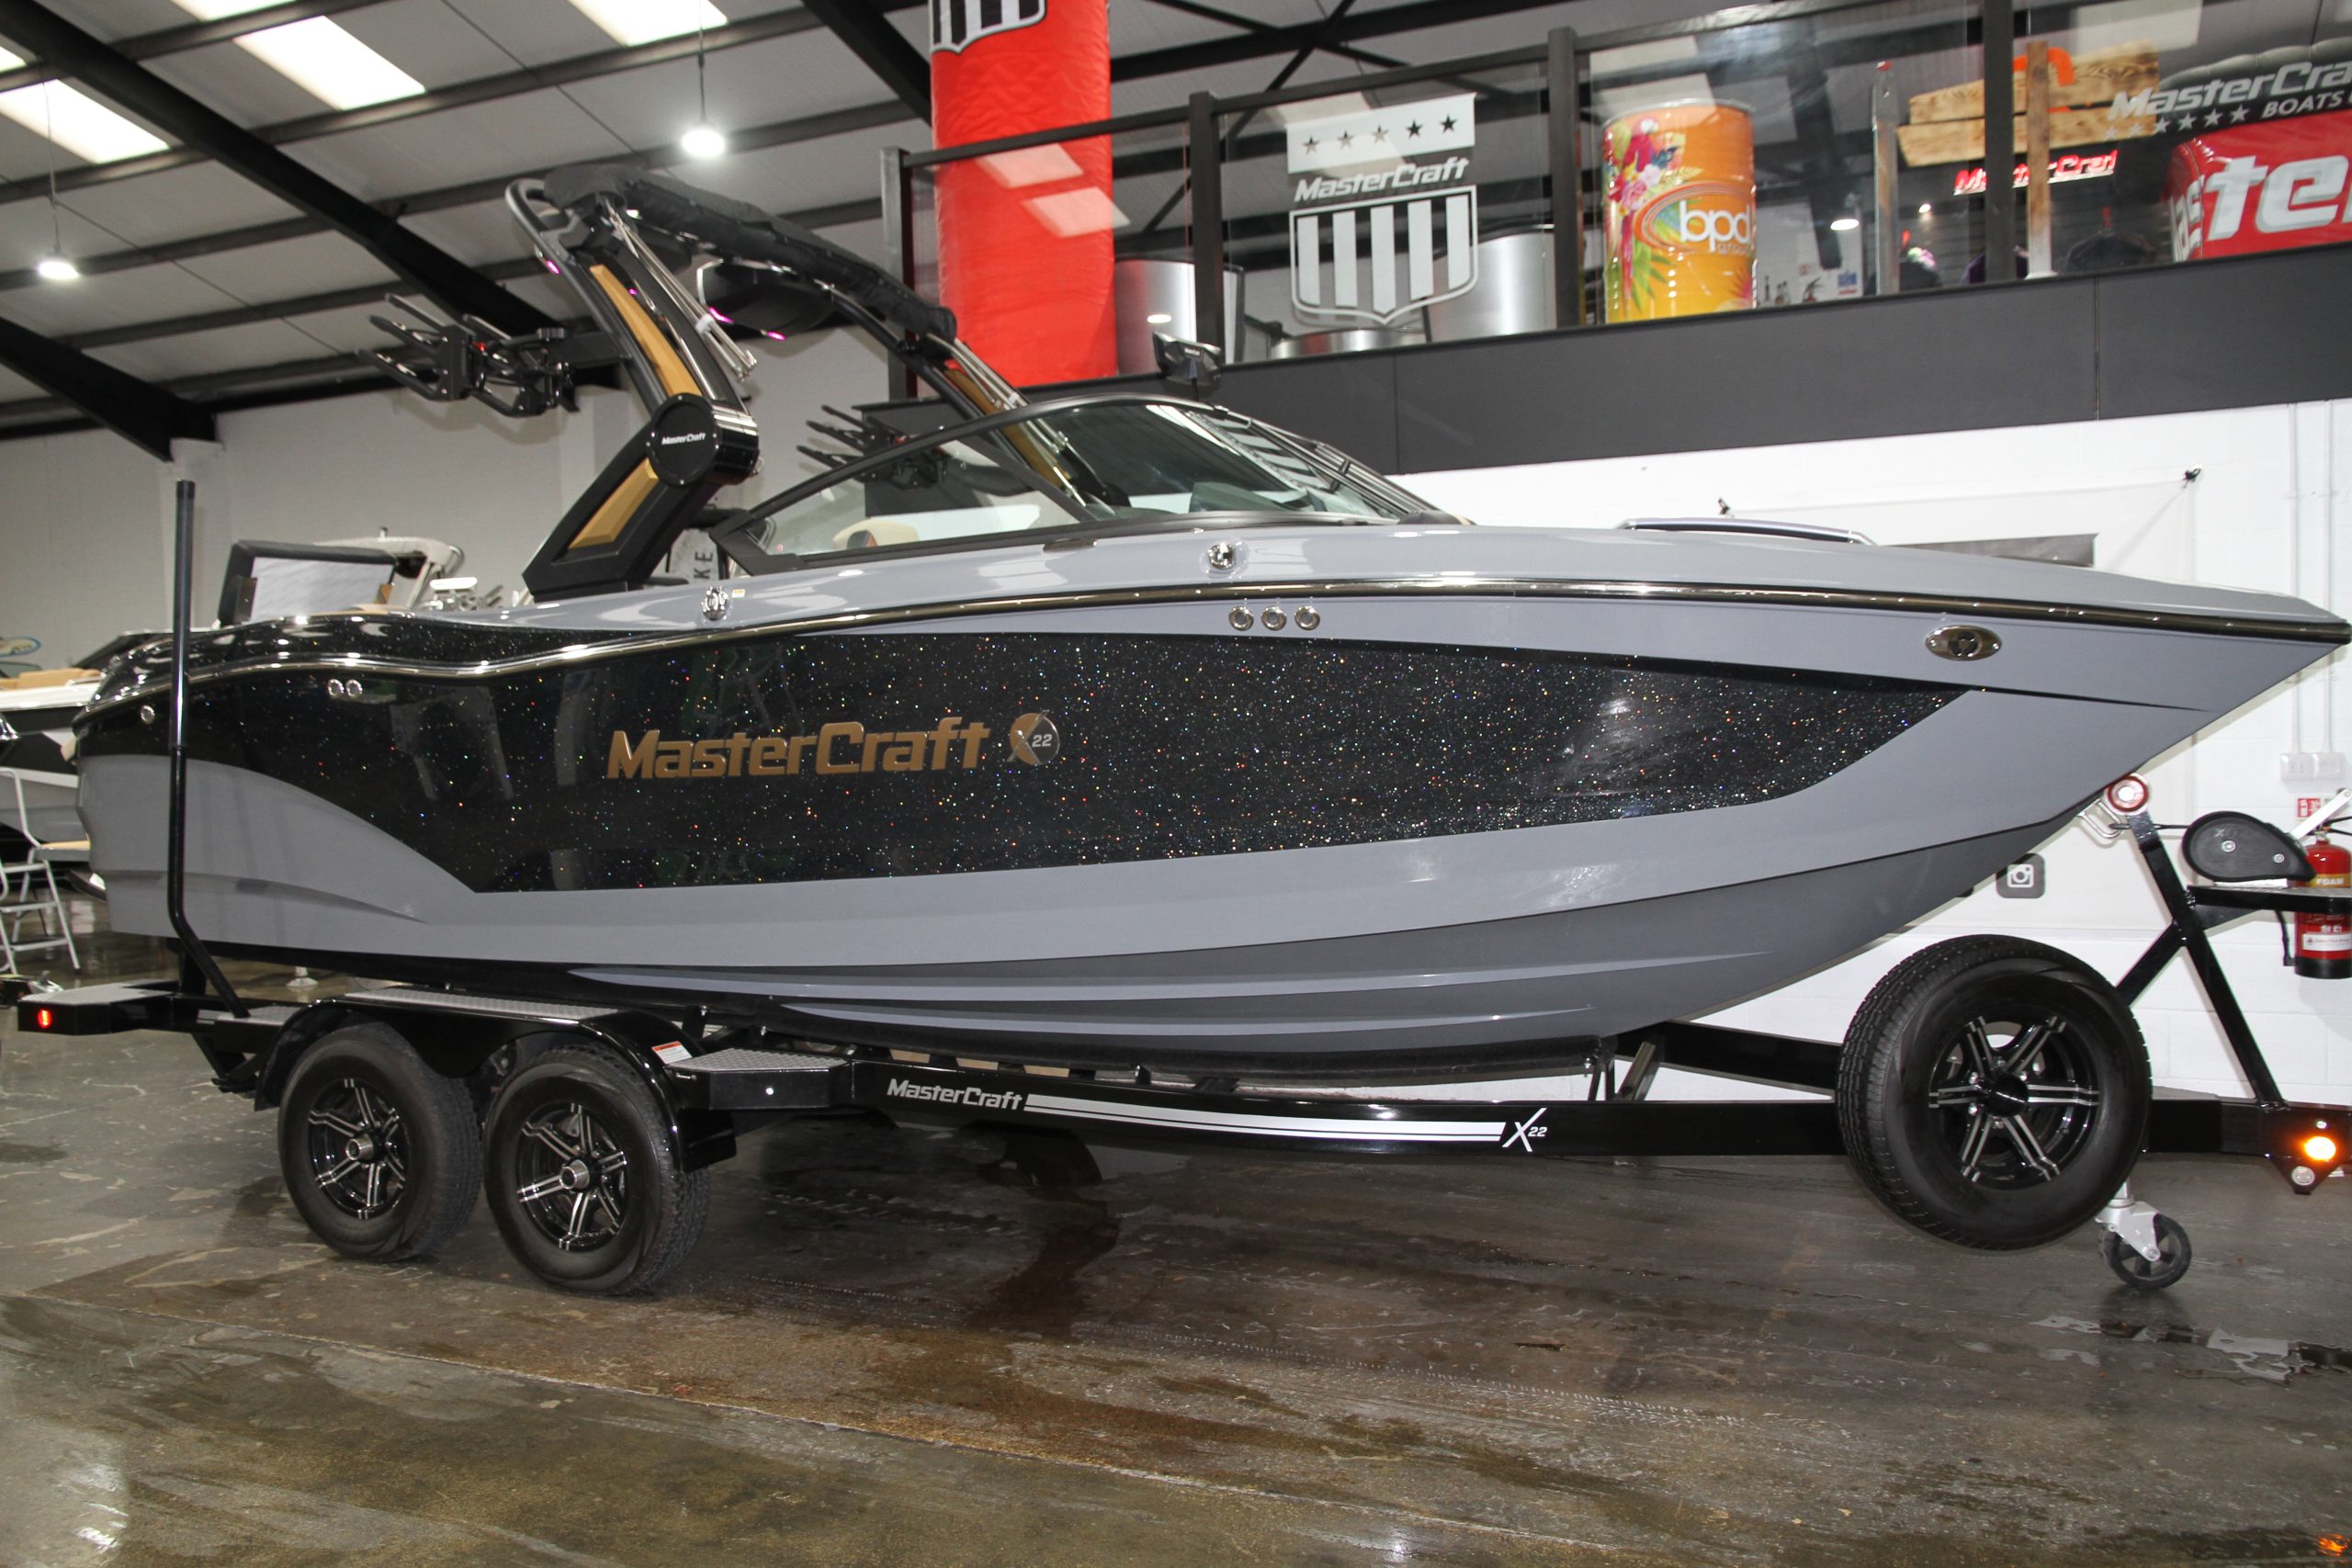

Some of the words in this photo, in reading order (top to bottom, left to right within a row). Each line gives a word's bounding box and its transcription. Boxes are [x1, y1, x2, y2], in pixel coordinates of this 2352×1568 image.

[2261, 90, 2345, 118] BOATS
[1294, 156, 1470, 203] MasterCraft
[662, 433, 707, 446] MasterCraft
[606, 716, 991, 779] MasterCraft
[2315, 876, 2345, 886] FOAM
[887, 1077, 1023, 1111] MasterCraft
